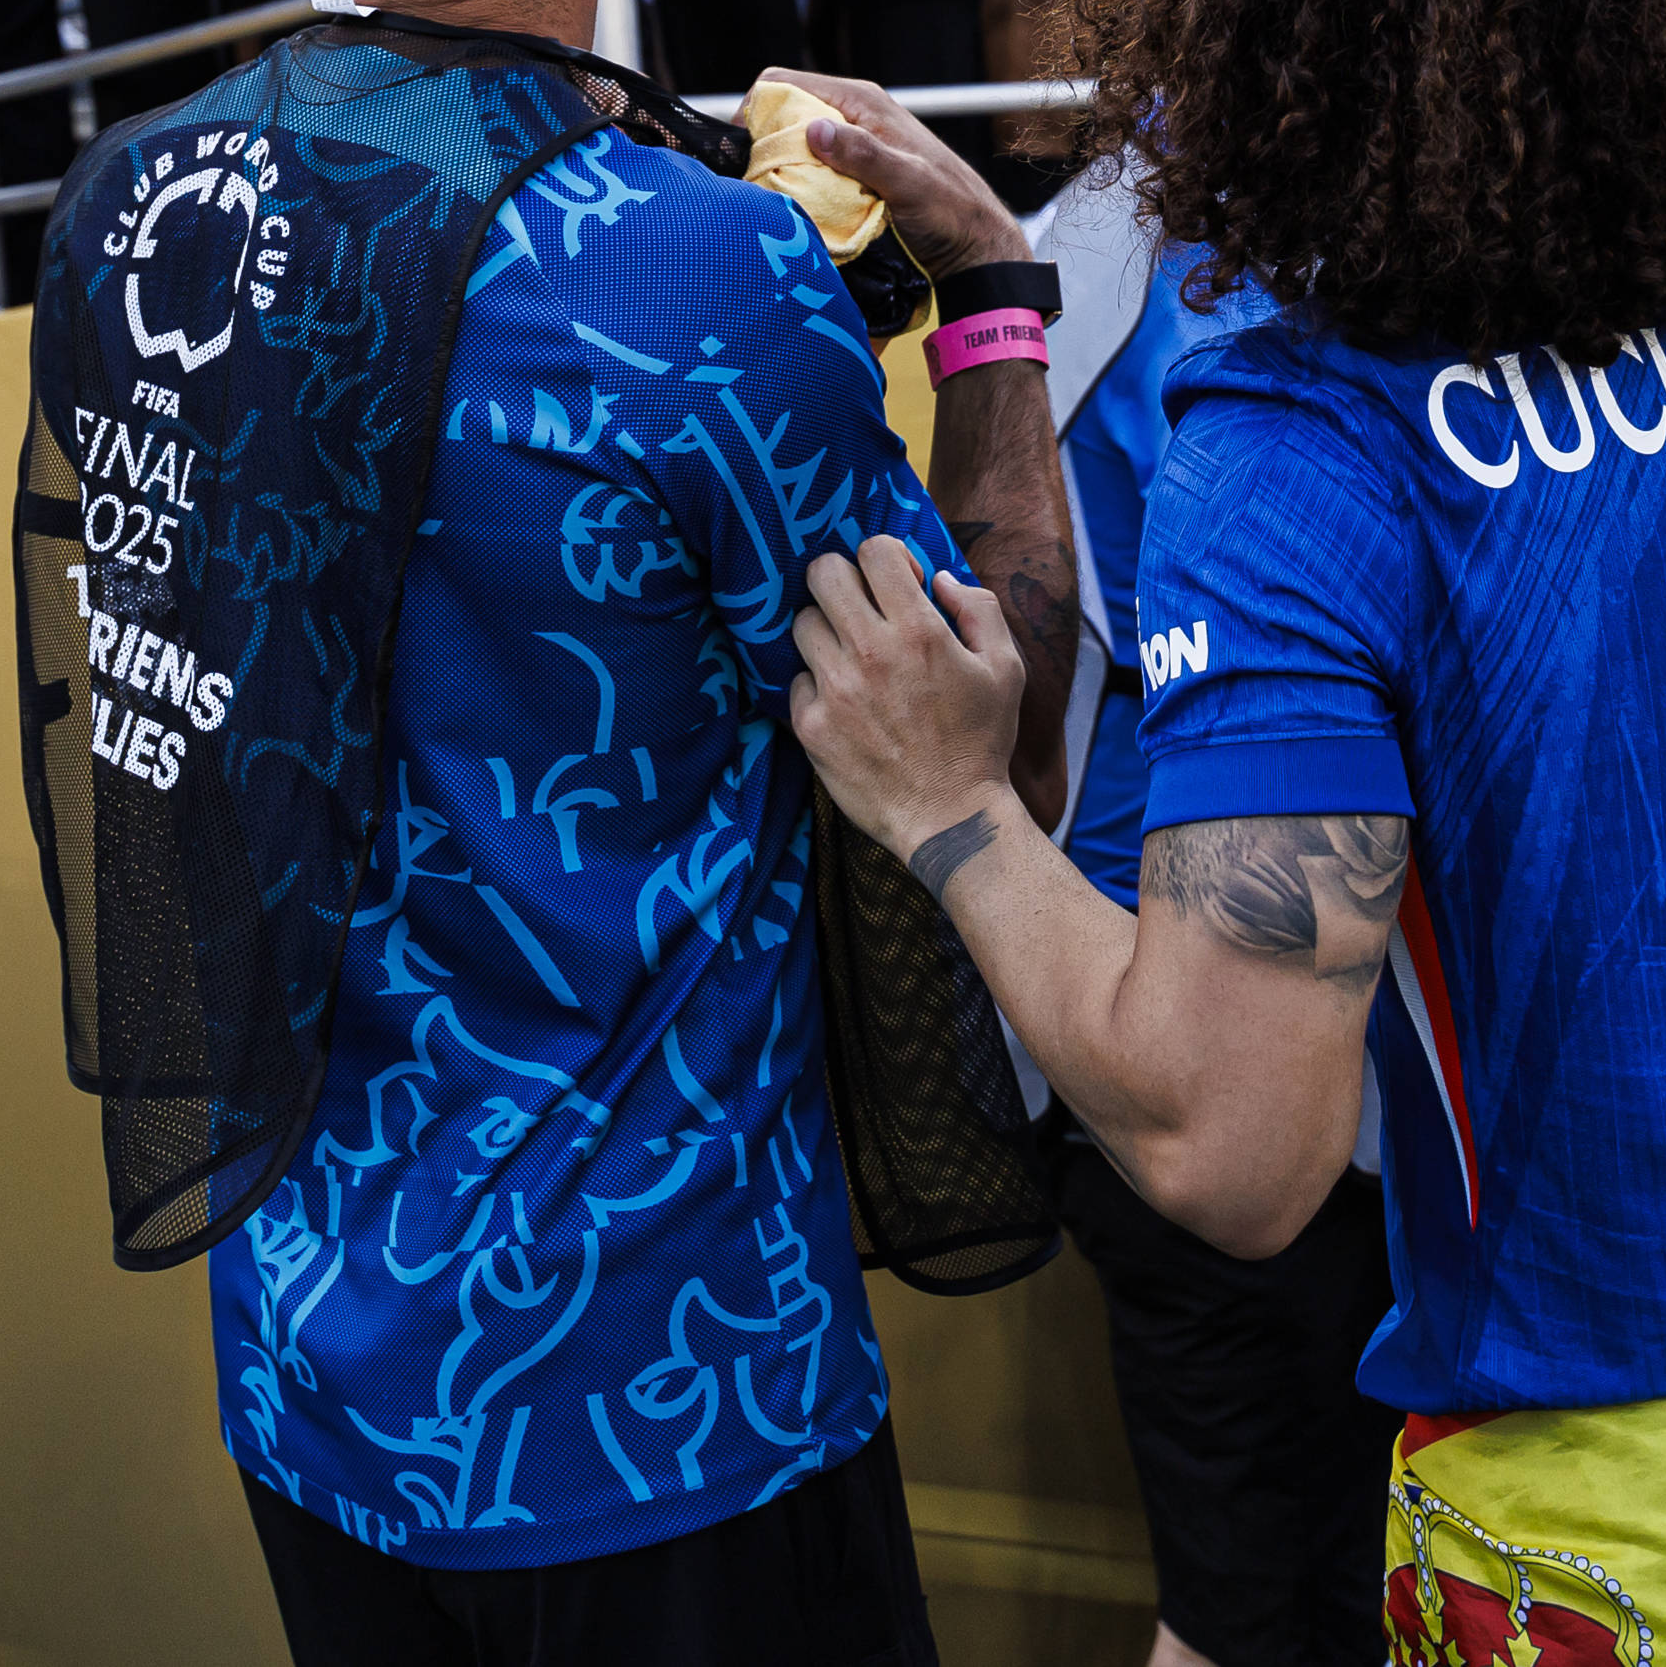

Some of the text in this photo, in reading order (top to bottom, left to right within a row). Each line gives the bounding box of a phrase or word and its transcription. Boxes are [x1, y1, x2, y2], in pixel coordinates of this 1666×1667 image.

[103, 131, 291, 311] CLUB WORD CUP
[963, 324, 1045, 350] TEAM FRIEND
[132, 379, 181, 419] FIFA
[81, 481, 180, 575] 025
